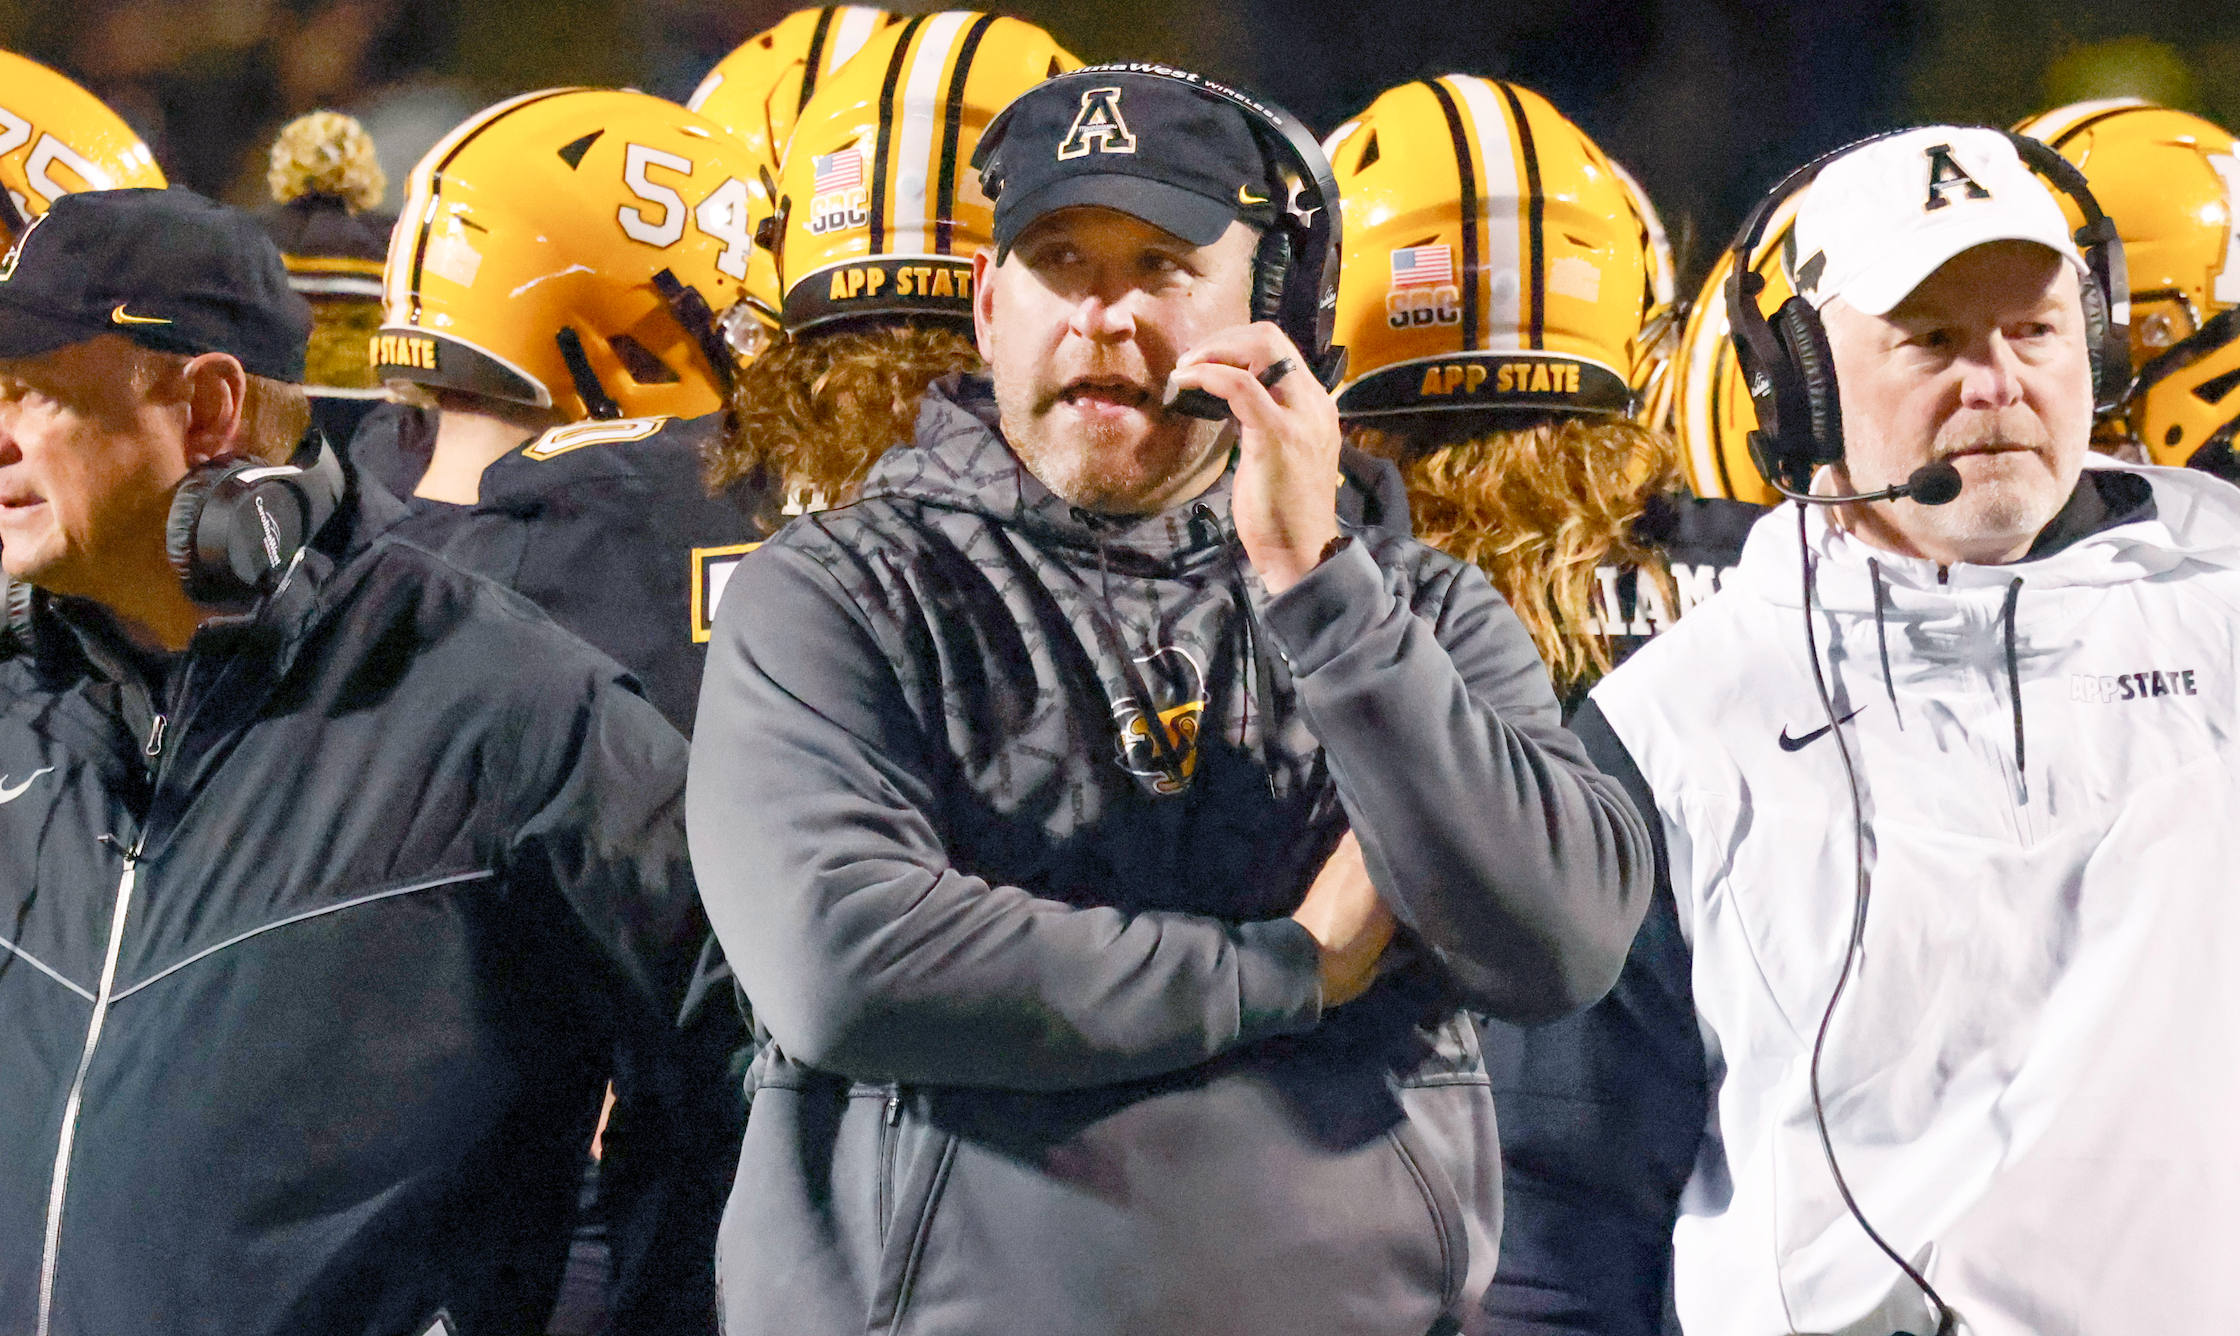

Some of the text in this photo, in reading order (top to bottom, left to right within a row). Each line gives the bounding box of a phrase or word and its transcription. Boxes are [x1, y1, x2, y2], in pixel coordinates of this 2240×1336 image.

[1057, 86, 1137, 161] A
[1204, 80, 1283, 126] WIRELESS
[1921, 142, 1993, 214] A
[617, 142, 752, 282] 54
[829, 266, 972, 300] APP STAT
[1421, 363, 1580, 396] APP STATE
